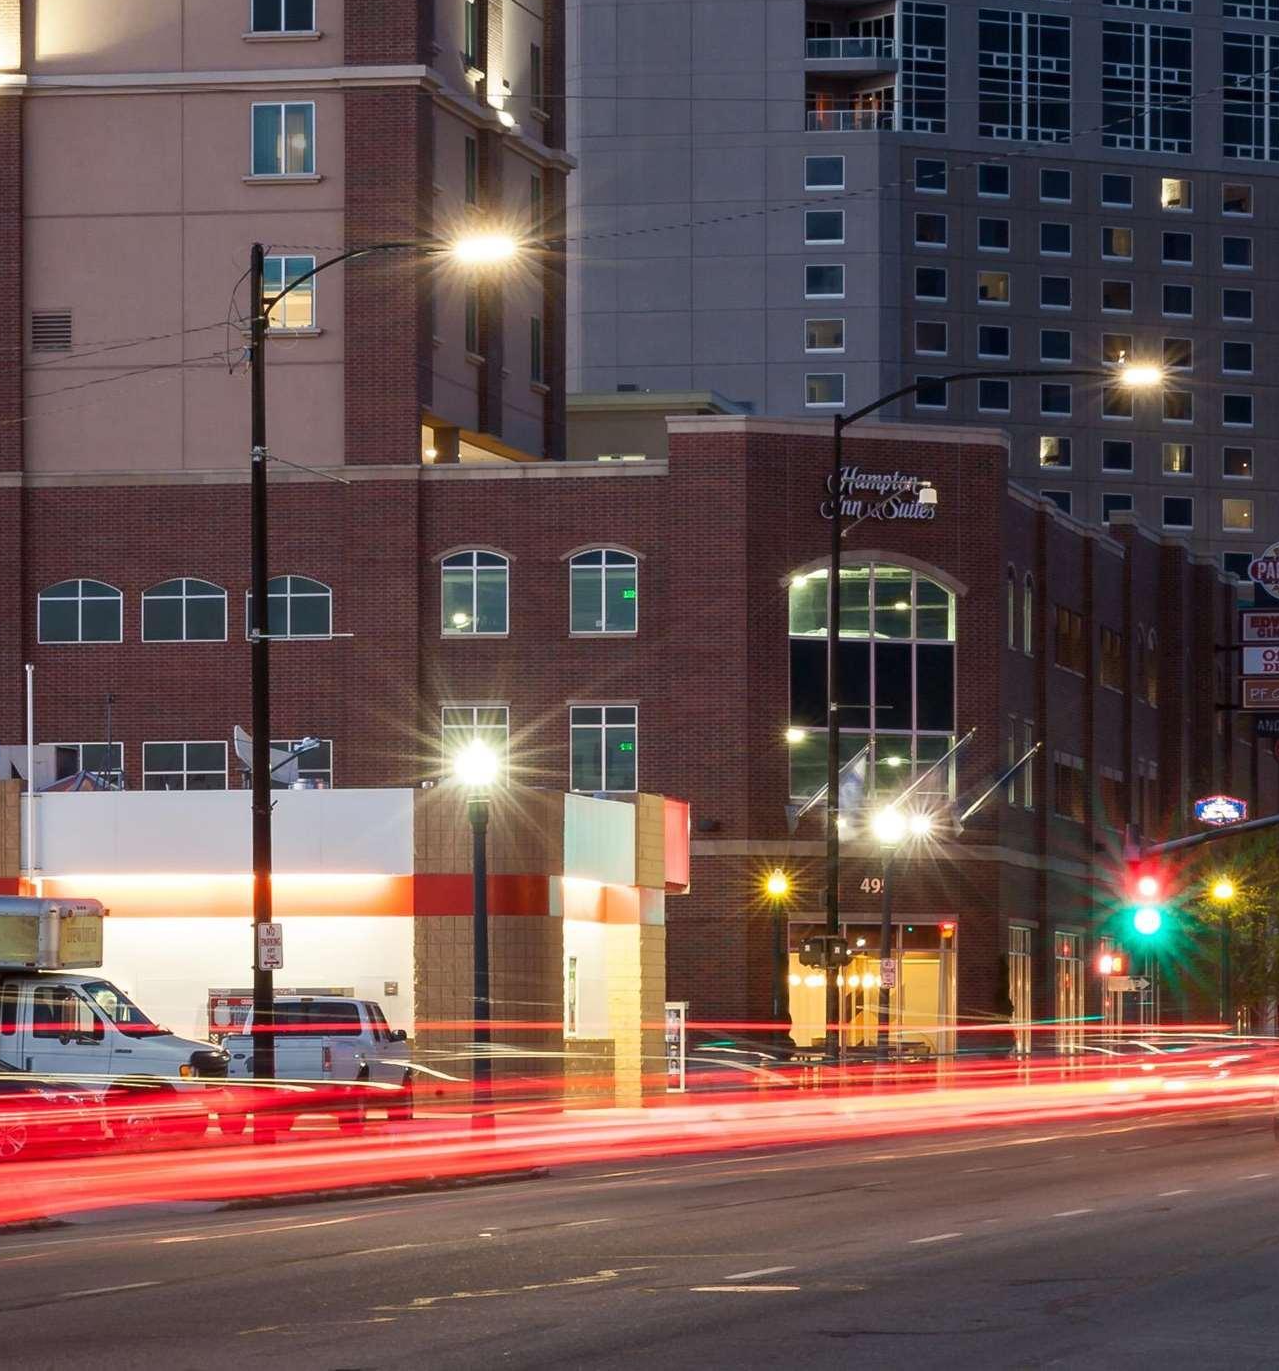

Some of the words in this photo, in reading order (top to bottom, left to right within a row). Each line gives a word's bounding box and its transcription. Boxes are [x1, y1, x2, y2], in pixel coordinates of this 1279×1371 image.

[827, 467, 919, 495] Hampton
[883, 496, 936, 519] Suites
[860, 878, 885, 894] 49
[266, 927, 275, 936] NO
